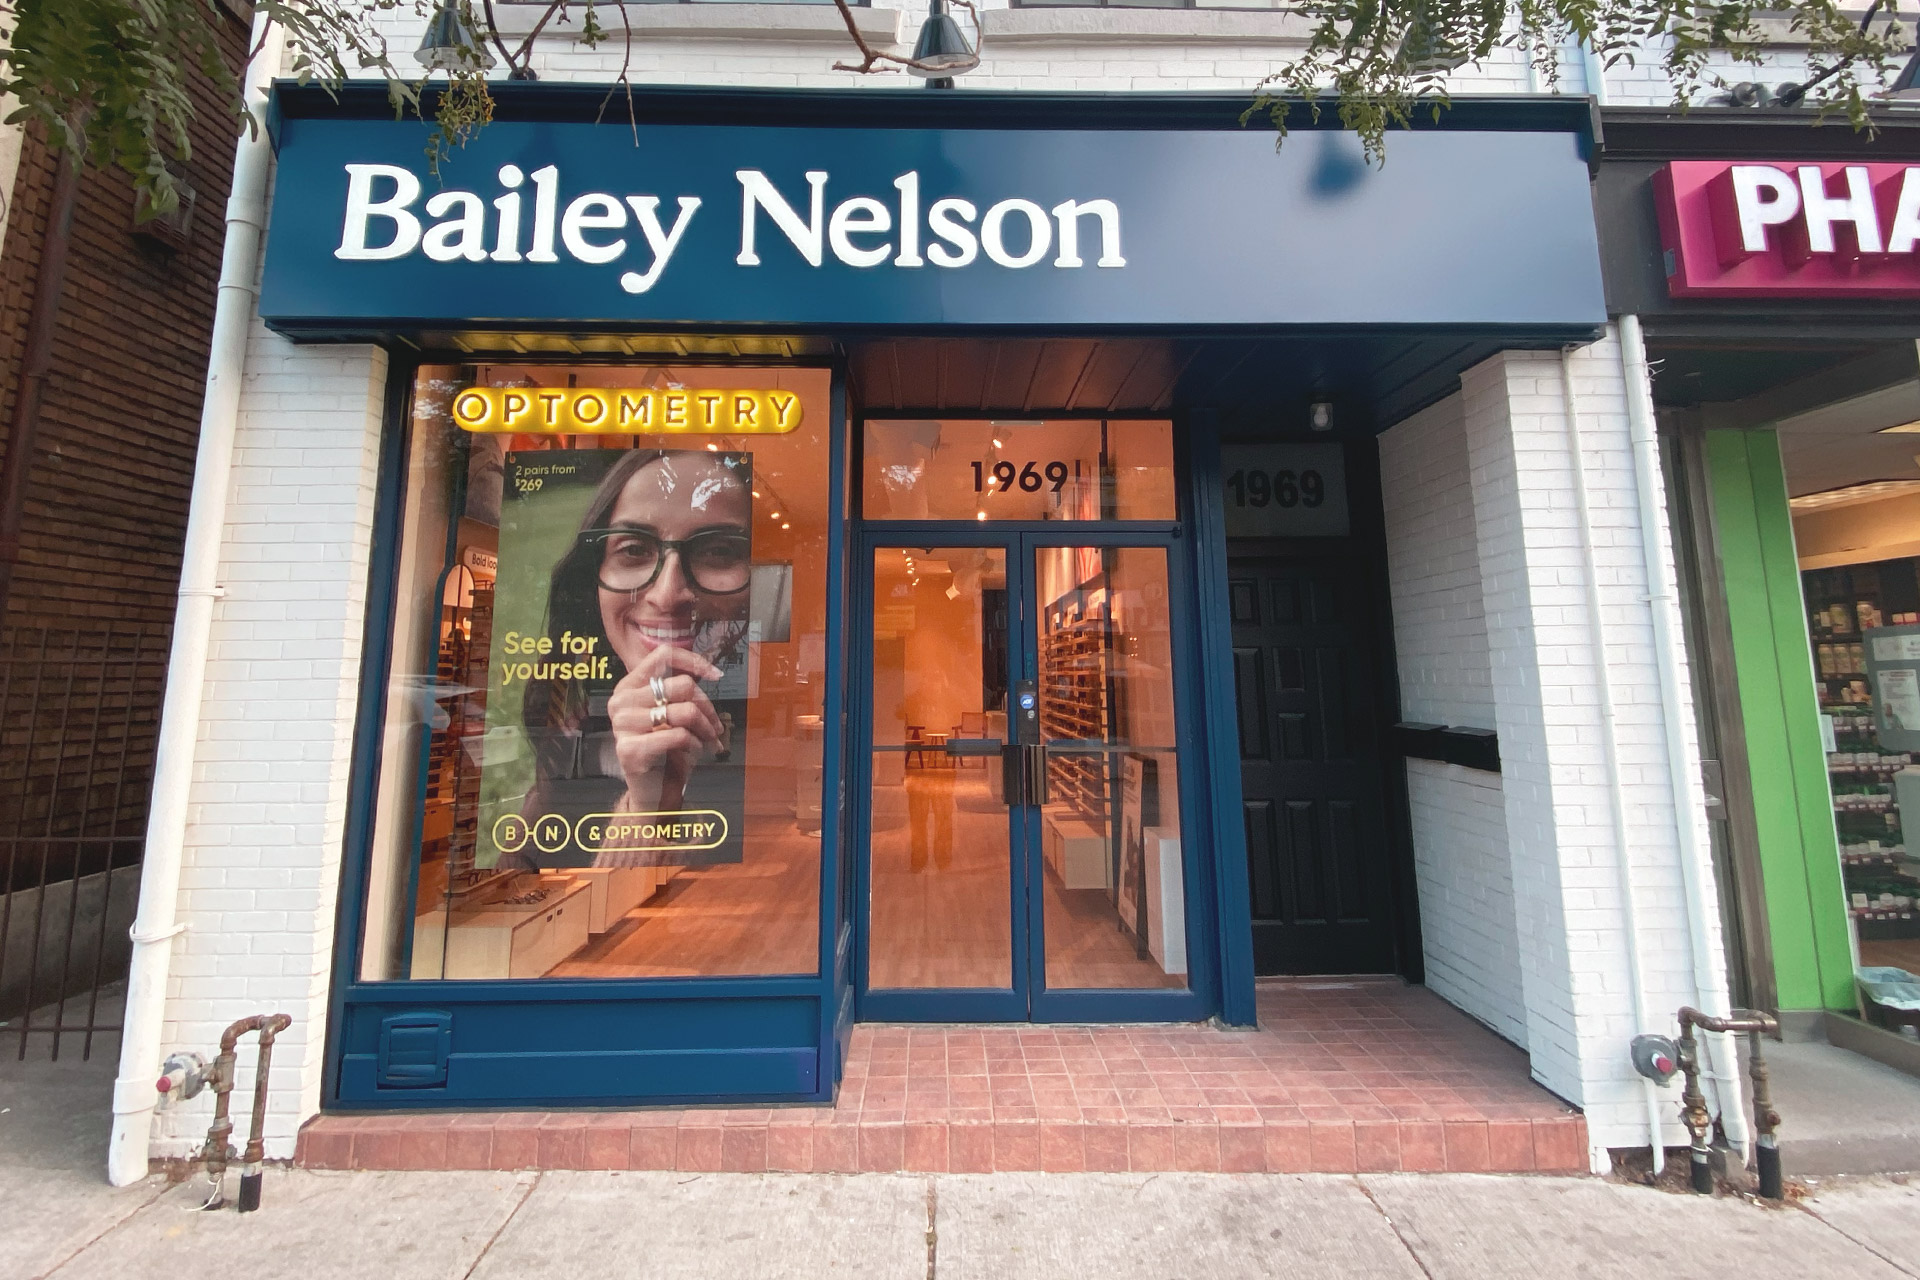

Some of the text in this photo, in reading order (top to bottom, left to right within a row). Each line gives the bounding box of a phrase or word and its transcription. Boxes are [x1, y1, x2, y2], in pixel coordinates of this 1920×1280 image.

[333, 163, 1127, 295] Bailey Nelson
[456, 392, 794, 425] OPTOMETRY
[515, 464, 576, 477] 2 pairs from
[970, 461, 1068, 493] 1969
[515, 478, 543, 492] $269
[1227, 469, 1325, 509] 1969
[471, 553, 487, 567] Bold
[504, 630, 599, 655] See for
[502, 656, 613, 686] yourself.
[605, 822, 716, 840] OPTOMETRY
